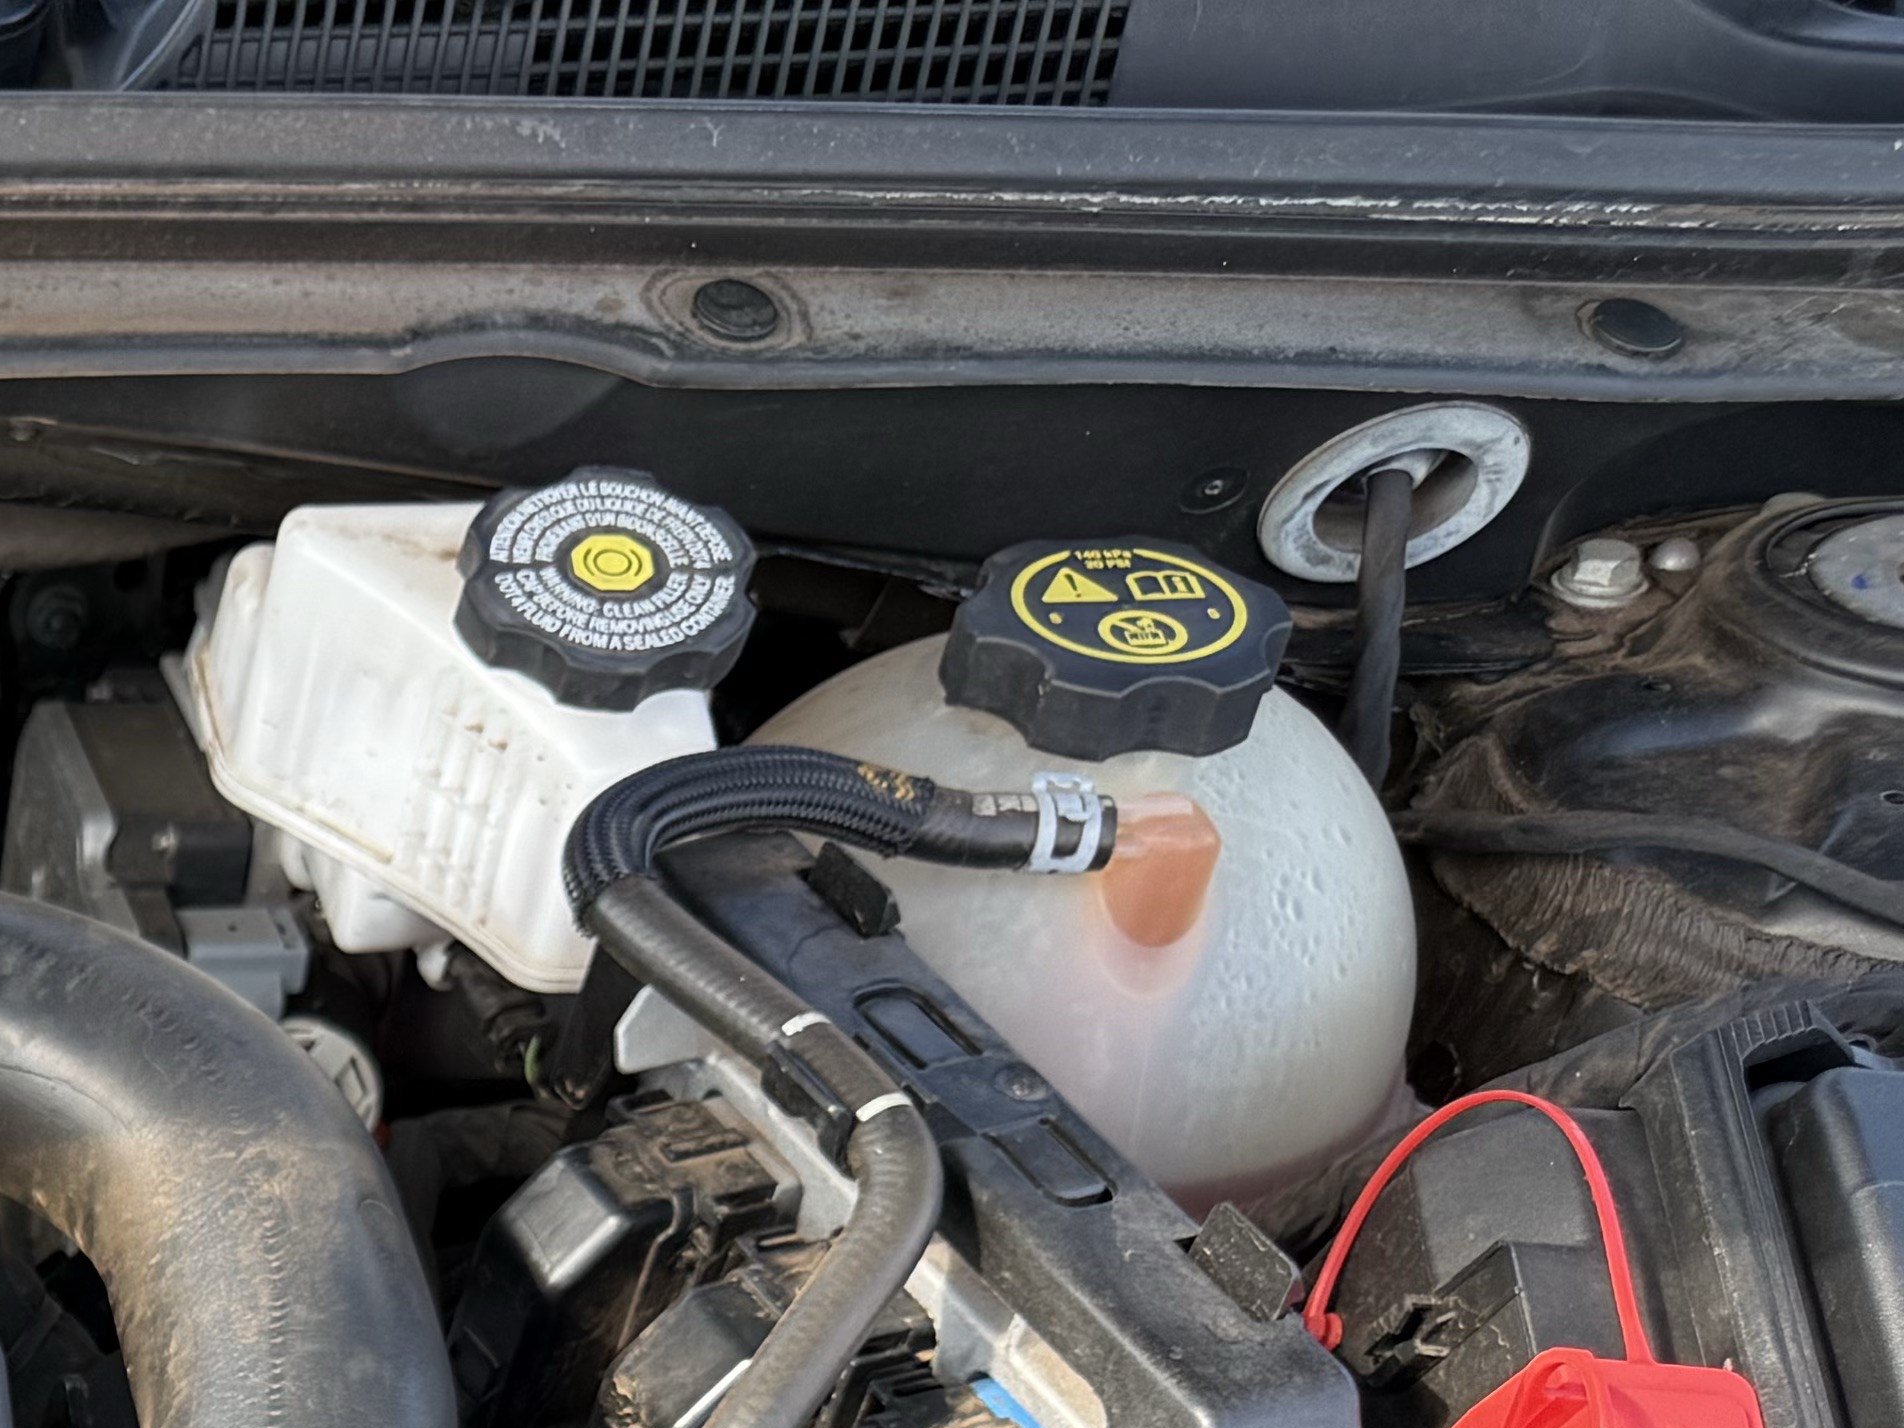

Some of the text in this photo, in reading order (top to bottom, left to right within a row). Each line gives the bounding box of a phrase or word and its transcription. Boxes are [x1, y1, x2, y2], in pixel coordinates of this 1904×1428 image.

[579, 481, 599, 497] LE
[516, 568, 544, 595] CAP
[602, 601, 656, 619] CLEAN
[558, 623, 609, 649] FROM
[608, 634, 623, 651] A
[622, 626, 686, 651] SEALED
